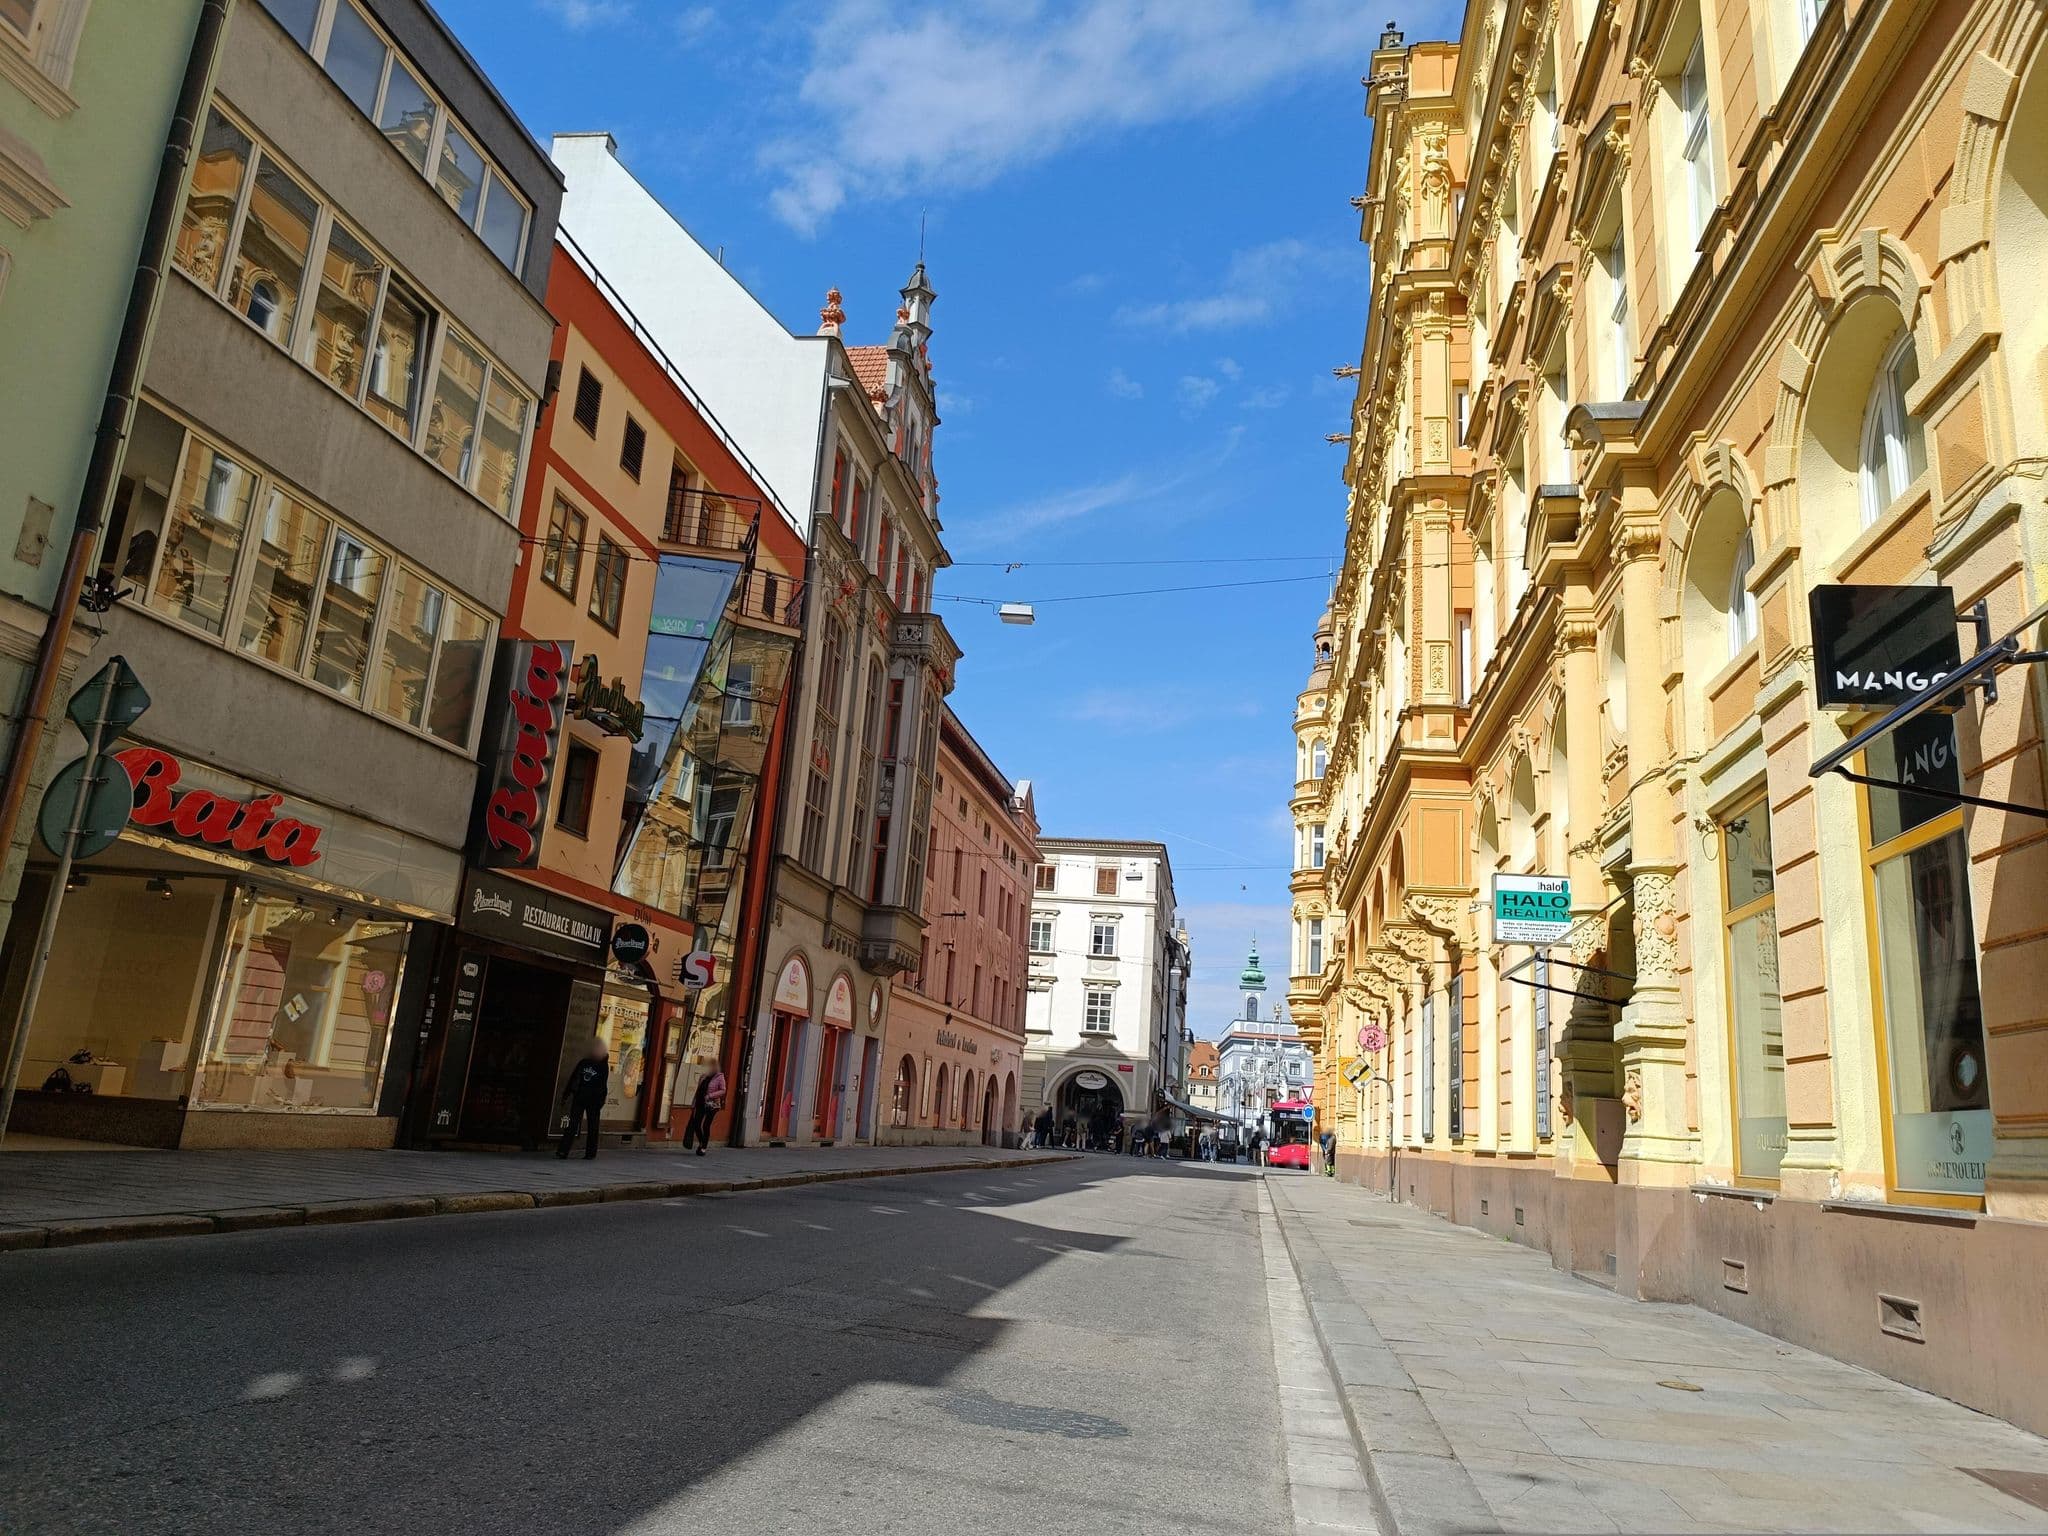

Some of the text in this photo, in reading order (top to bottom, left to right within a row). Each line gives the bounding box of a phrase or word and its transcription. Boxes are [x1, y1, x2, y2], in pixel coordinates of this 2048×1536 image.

[662, 618, 688, 628] WIN
[1502, 894, 1569, 908] HALO
[1502, 907, 1569, 919] REALITY
[523, 904, 570, 934] RESTAURACE
[571, 920, 593, 941] KARLA
